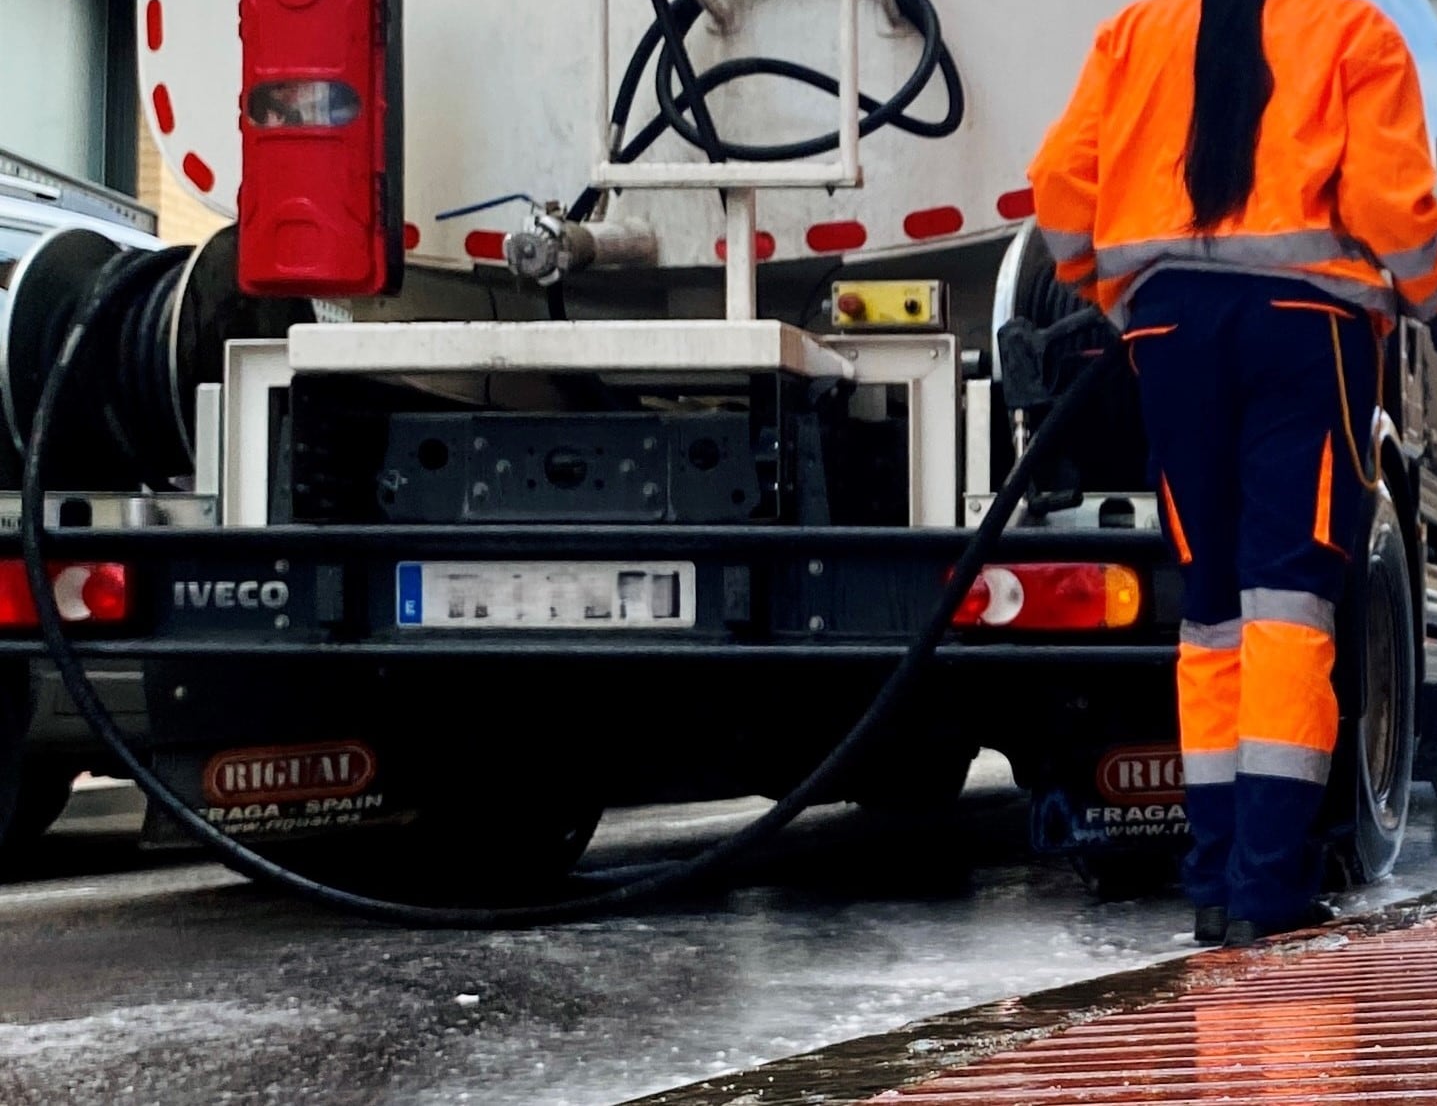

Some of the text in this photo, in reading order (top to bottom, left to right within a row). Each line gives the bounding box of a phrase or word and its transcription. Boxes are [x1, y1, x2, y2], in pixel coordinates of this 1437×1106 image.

[173, 580, 290, 609] IVECO
[1118, 758, 1185, 788] RIG
[305, 793, 383, 814] SPAIN
[1086, 804, 1186, 823] FRAGA
